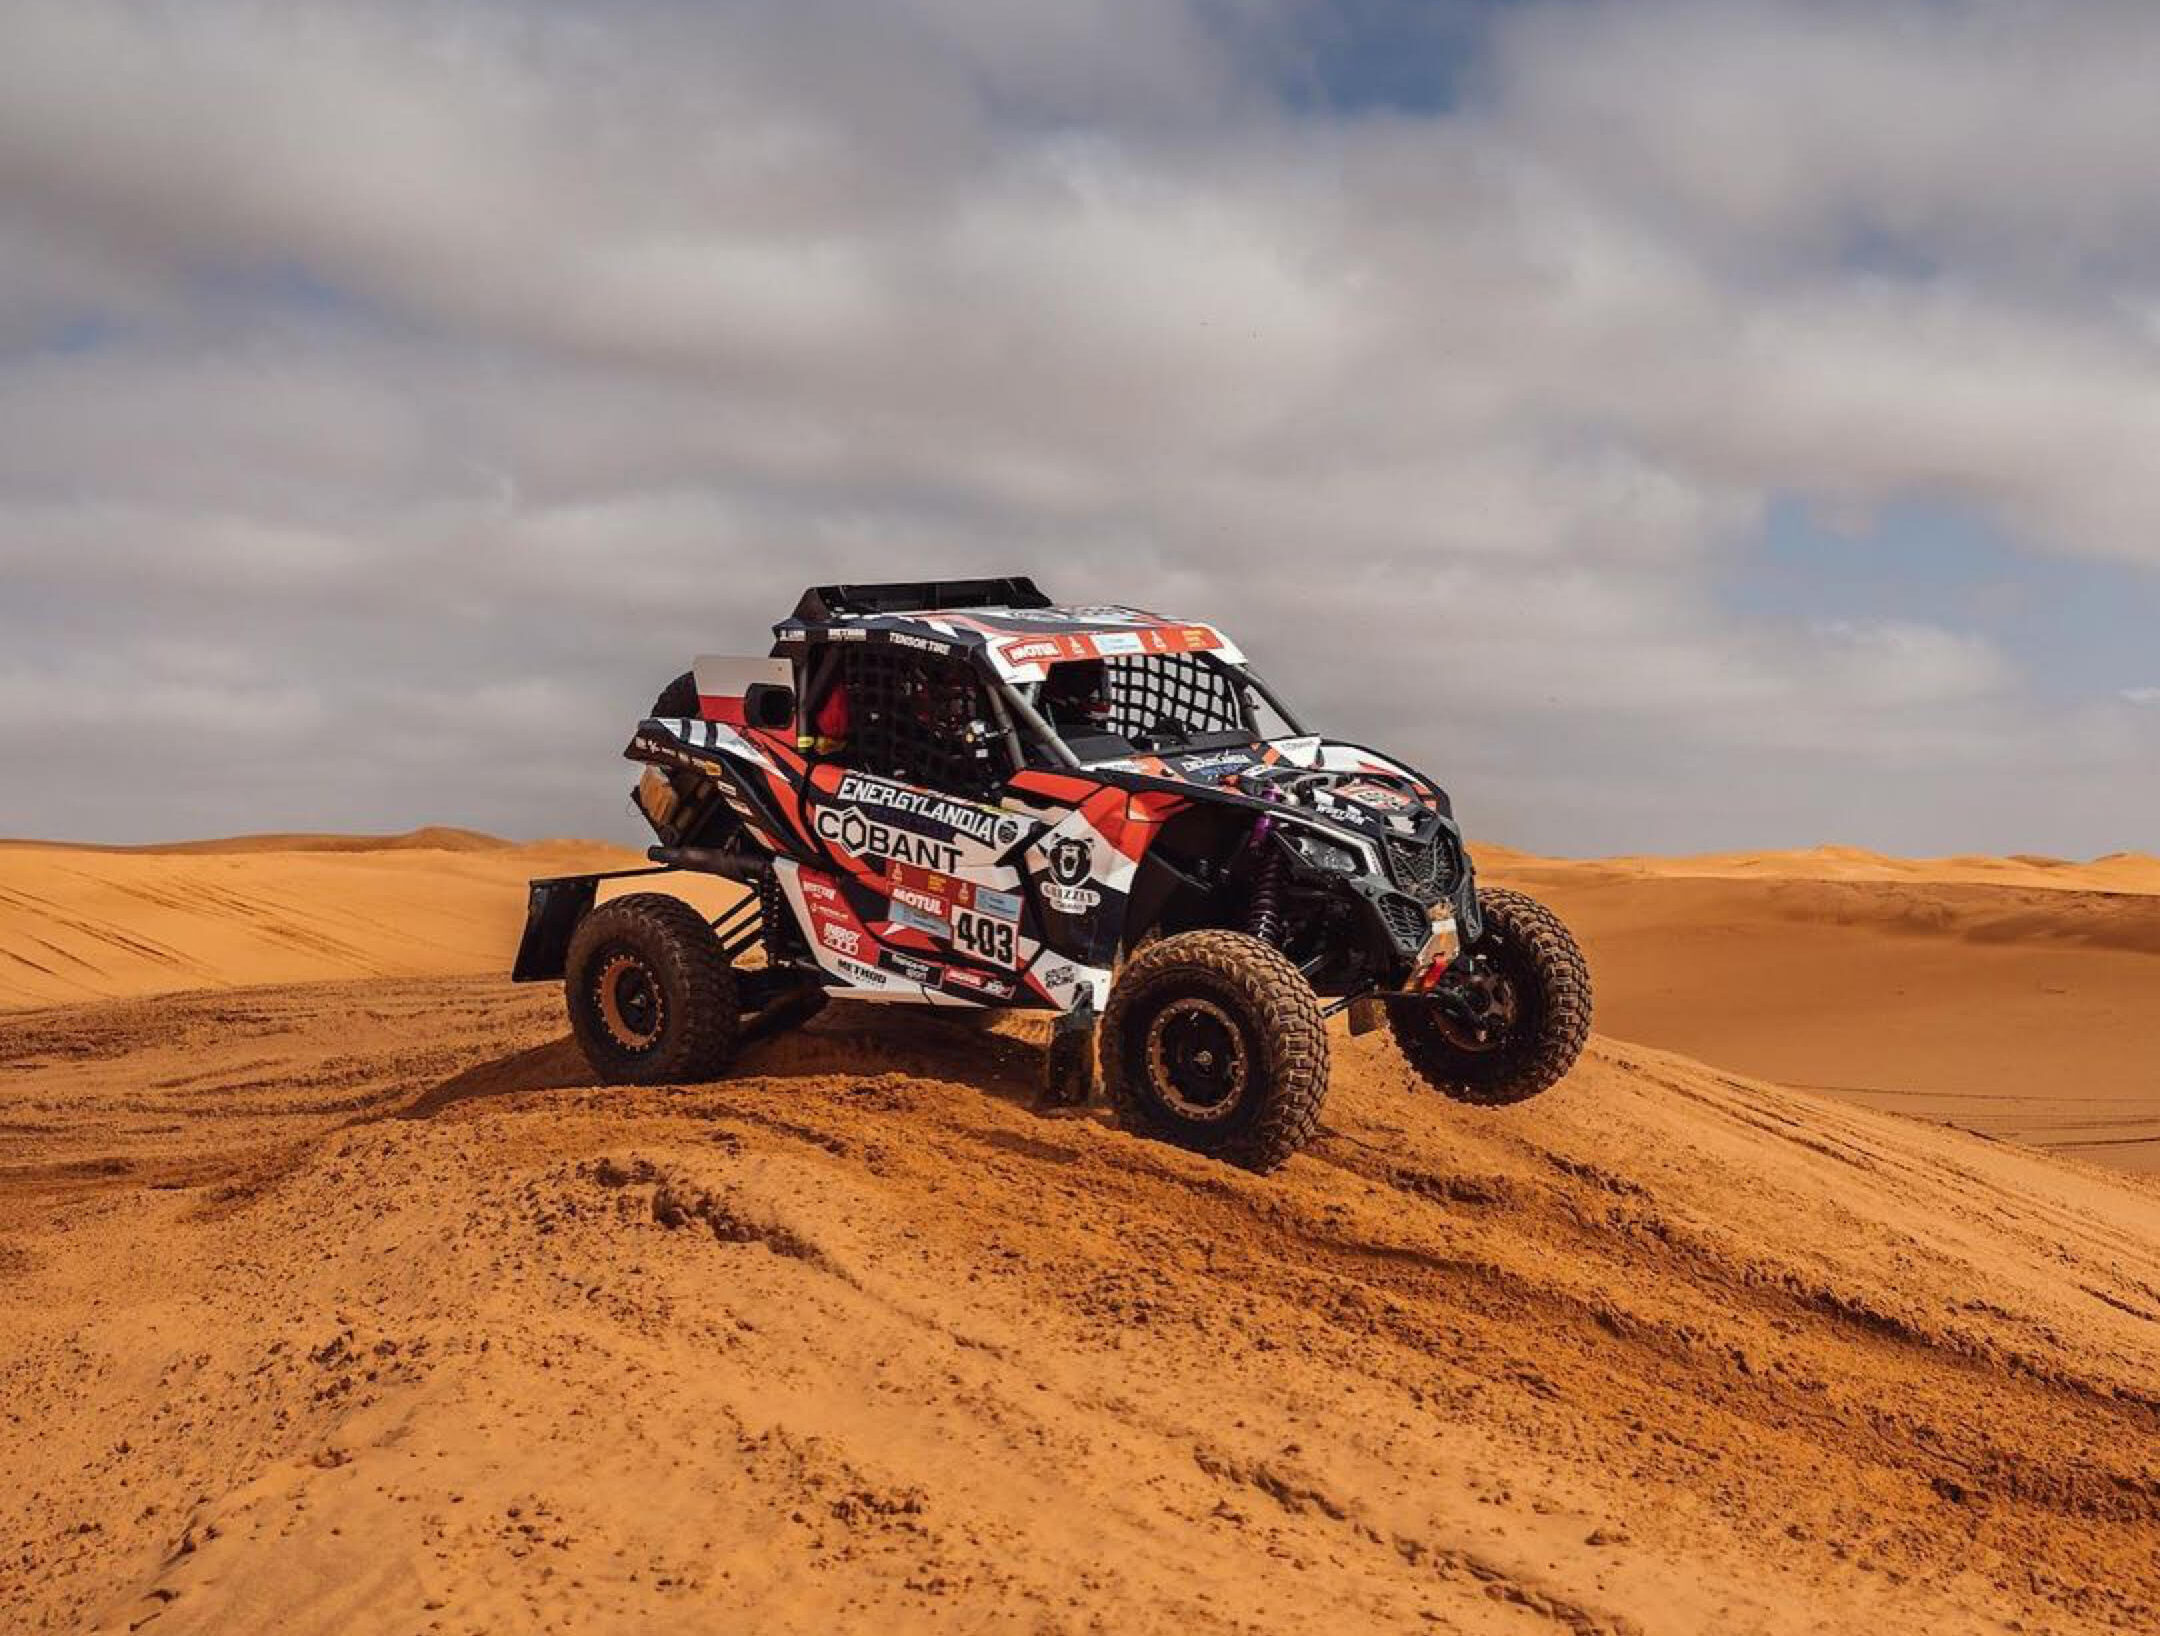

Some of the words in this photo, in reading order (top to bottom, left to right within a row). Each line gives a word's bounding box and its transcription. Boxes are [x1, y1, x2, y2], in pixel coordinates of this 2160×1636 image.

[837, 777, 993, 842] ENERGYLANDIA
[818, 808, 962, 873] COBANT
[892, 888, 943, 916] MOTUL
[957, 912, 1013, 963] 403
